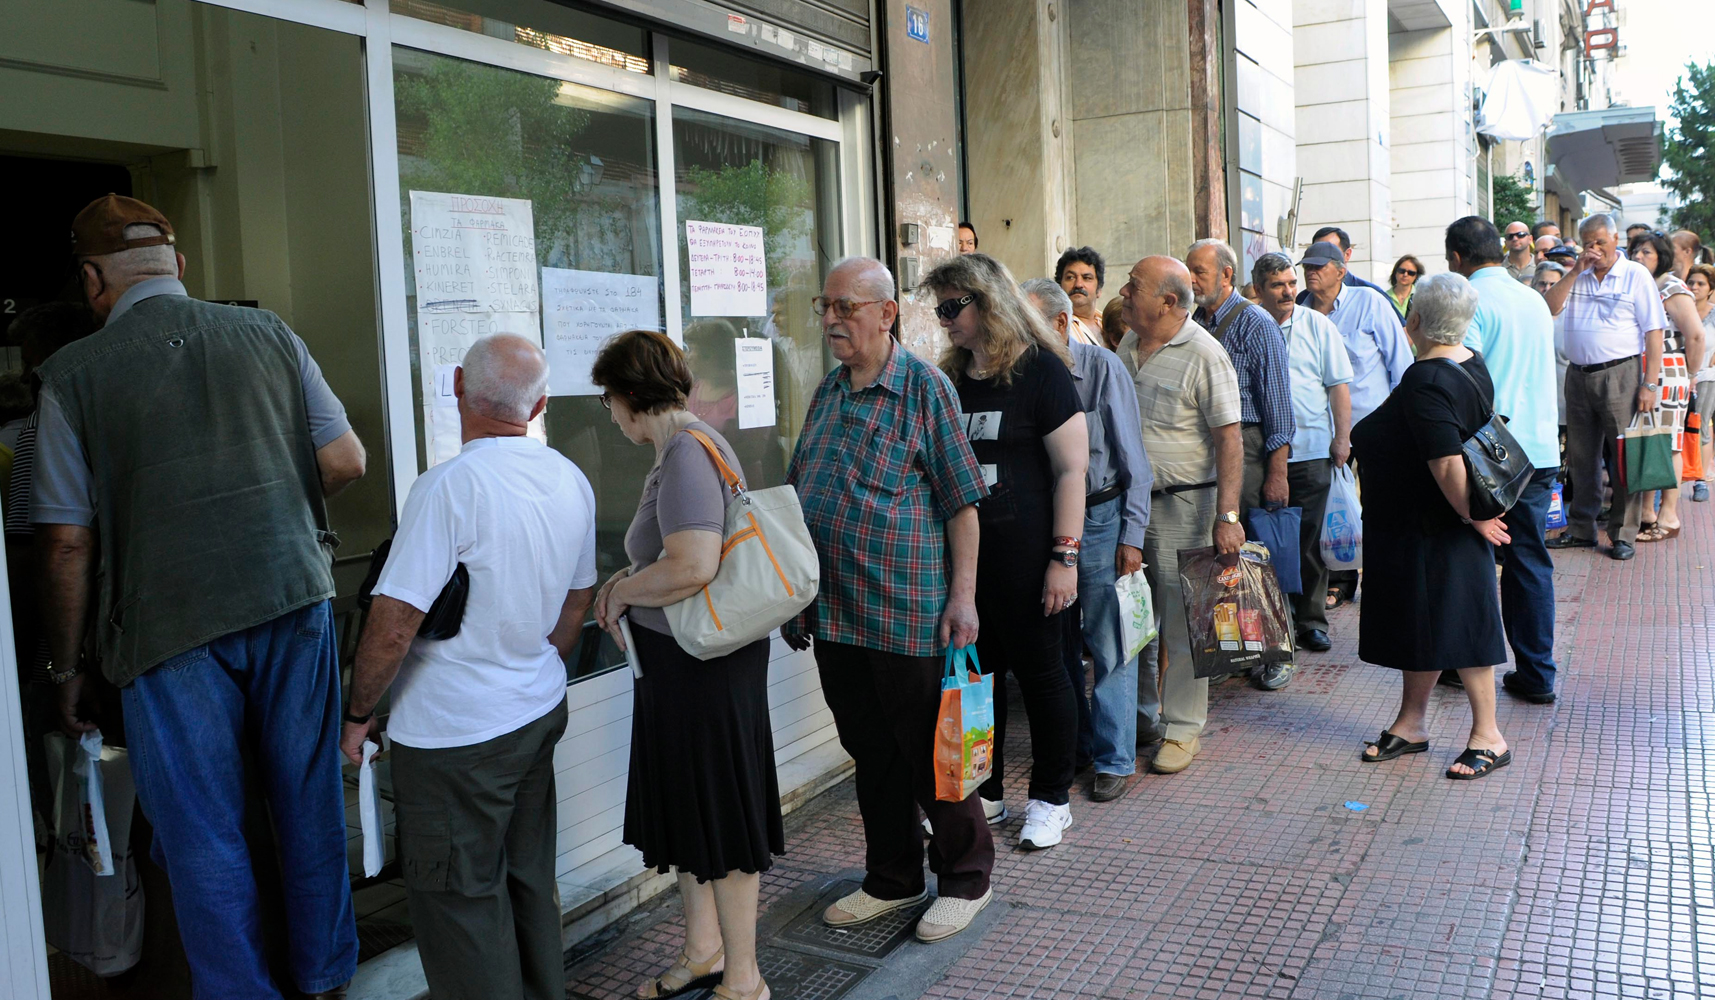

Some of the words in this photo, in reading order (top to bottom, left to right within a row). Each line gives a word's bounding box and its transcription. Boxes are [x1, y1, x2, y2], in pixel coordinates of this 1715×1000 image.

[913, 14, 924, 36] 16
[451, 196, 504, 213] ΠΡΟΣΟΧΗ
[451, 217, 462, 227] ΤΑ
[469, 218, 505, 229] ΦΑΡΜΑΚΑ
[688, 225, 695, 234] ΤΑ
[739, 227, 760, 238] ΕΟΠΥΥ
[486, 232, 535, 250] REMICADE
[424, 245, 471, 258] ENBREL
[425, 263, 472, 277] HUMIRA
[488, 266, 530, 280] SIMPONI
[426, 281, 474, 293] KINERET
[490, 282, 536, 295] STELARA
[625, 286, 642, 297] 184
[4, 299, 16, 313] 2
[431, 319, 498, 335] FORSTEO
